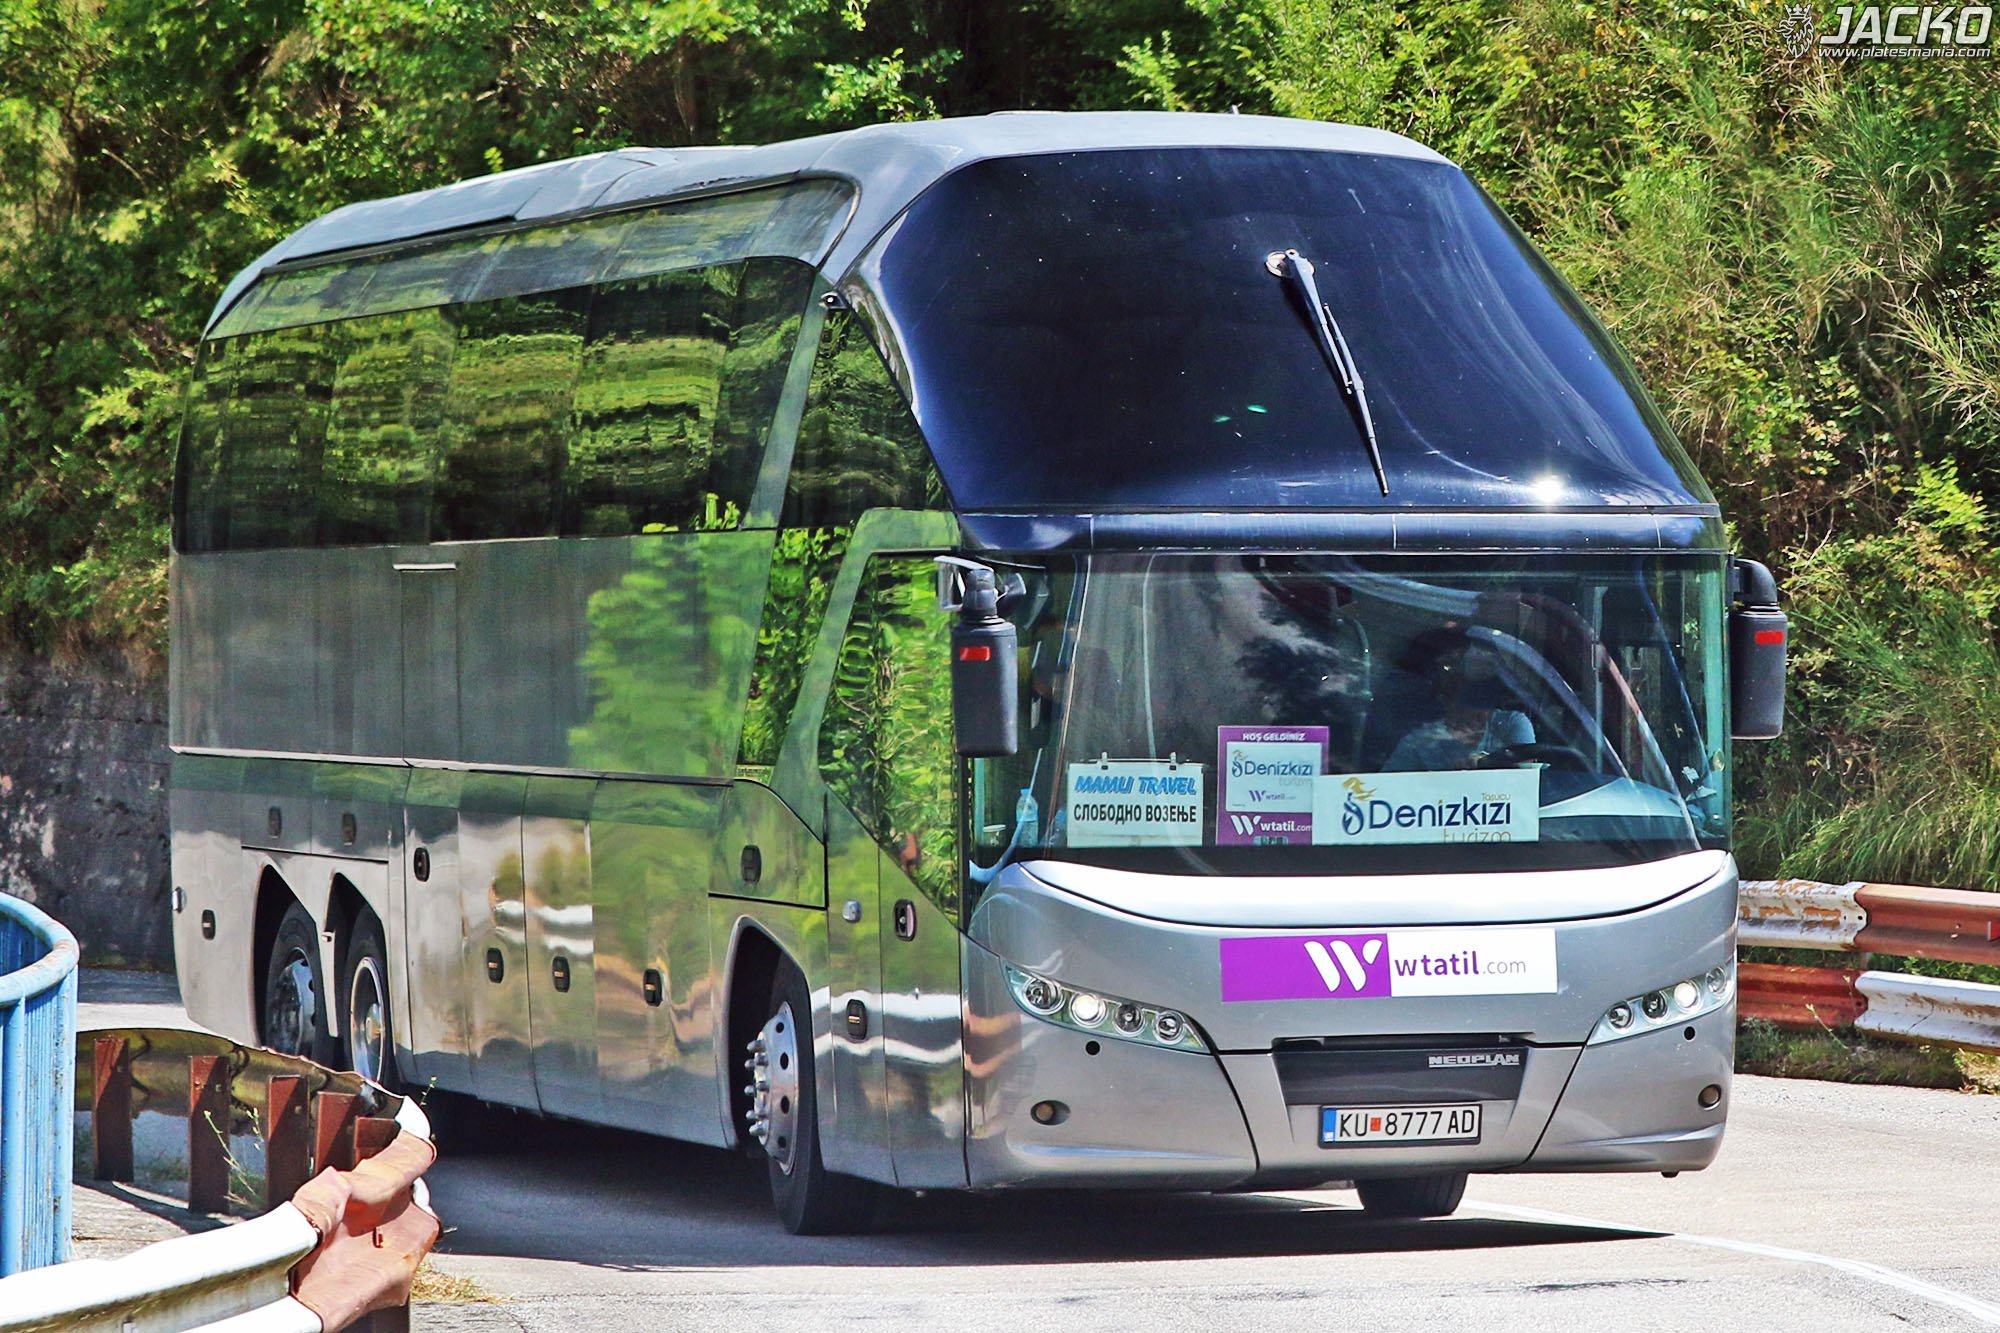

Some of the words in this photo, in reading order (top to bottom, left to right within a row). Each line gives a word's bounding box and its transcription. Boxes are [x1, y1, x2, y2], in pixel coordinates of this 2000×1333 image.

[1138, 776, 1198, 796] TRAVEL
[1073, 803, 1142, 825] СЛОБОДНО
[1146, 804, 1197, 823] ВОЗЕЊЕ
[1260, 820, 1313, 832] wtatil.com
[1395, 950, 1527, 977] wtatil.com
[1428, 1053, 1520, 1068] NEOPLAN
[1339, 1113, 1368, 1138] KU
[1385, 1110, 1443, 1136] 8777
[1447, 1109, 1475, 1134] AD
